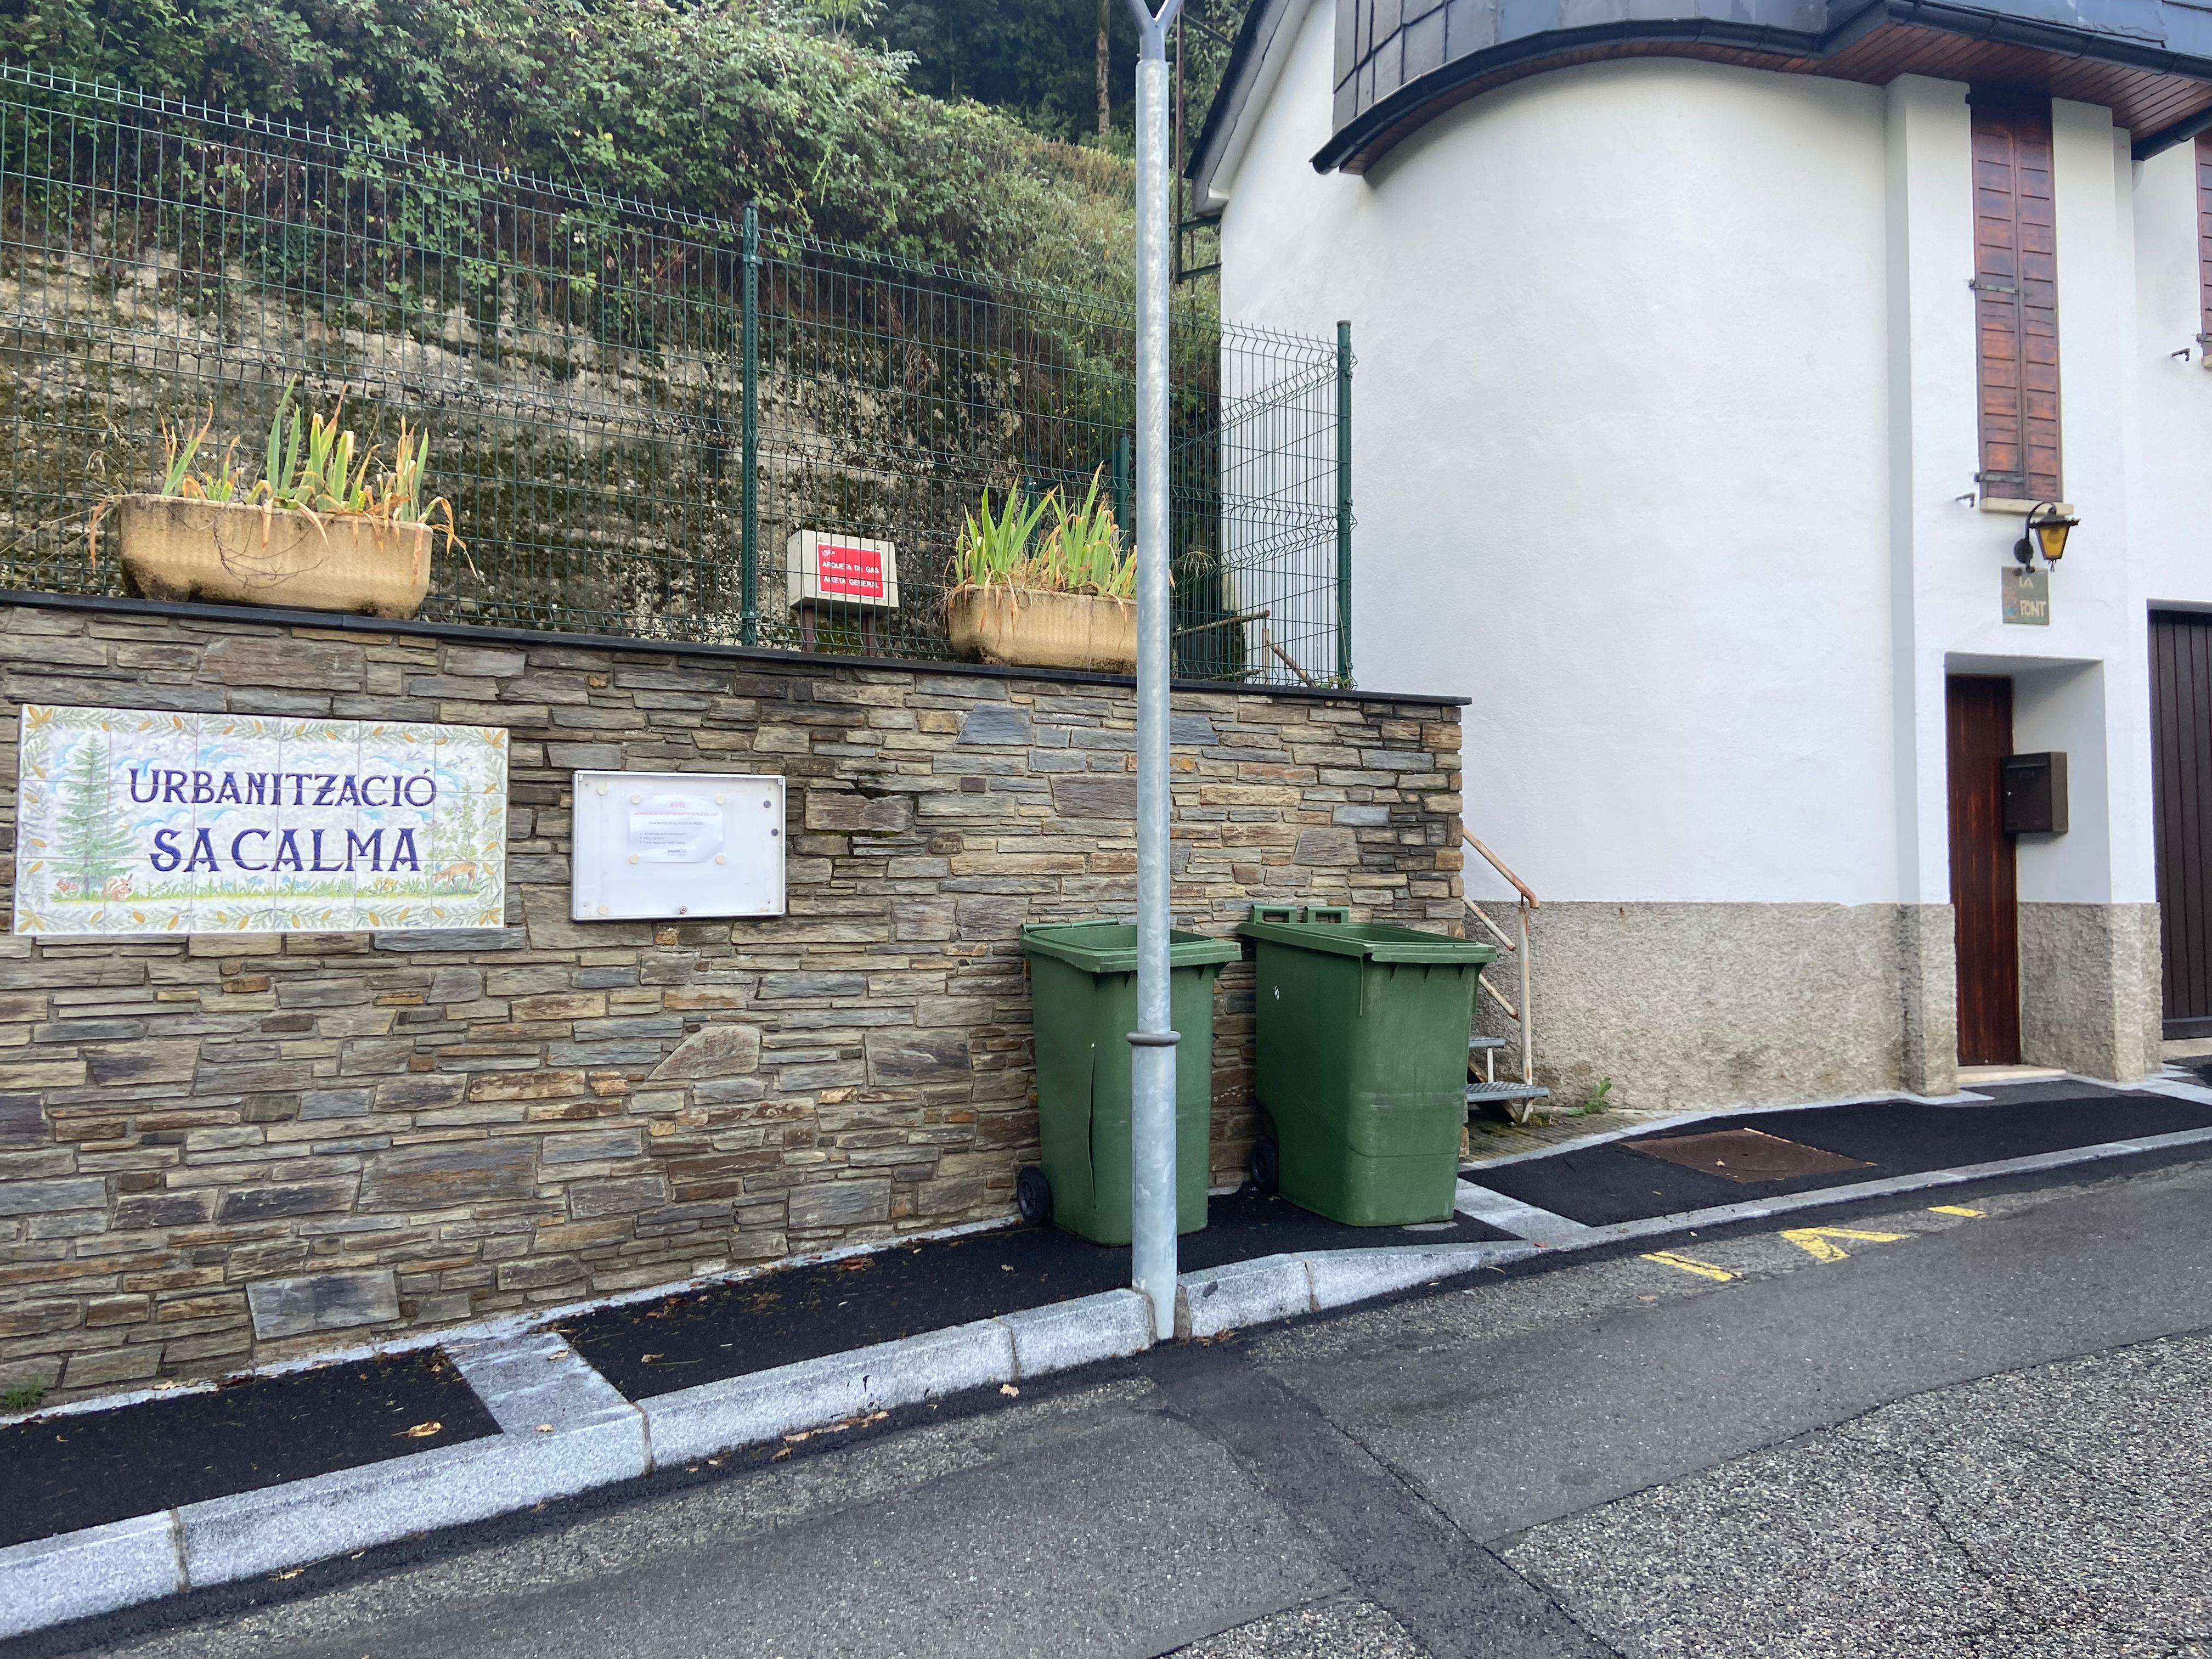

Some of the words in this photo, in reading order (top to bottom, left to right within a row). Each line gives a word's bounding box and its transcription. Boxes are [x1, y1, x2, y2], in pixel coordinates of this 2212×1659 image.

[849, 579, 880, 588] GENERAL
[2019, 577, 2034, 588] LA
[2019, 600, 2047, 617] FONT
[128, 768, 437, 807] URBANITZACIÓ
[149, 828, 221, 872] SA
[232, 828, 420, 872] CALMA
